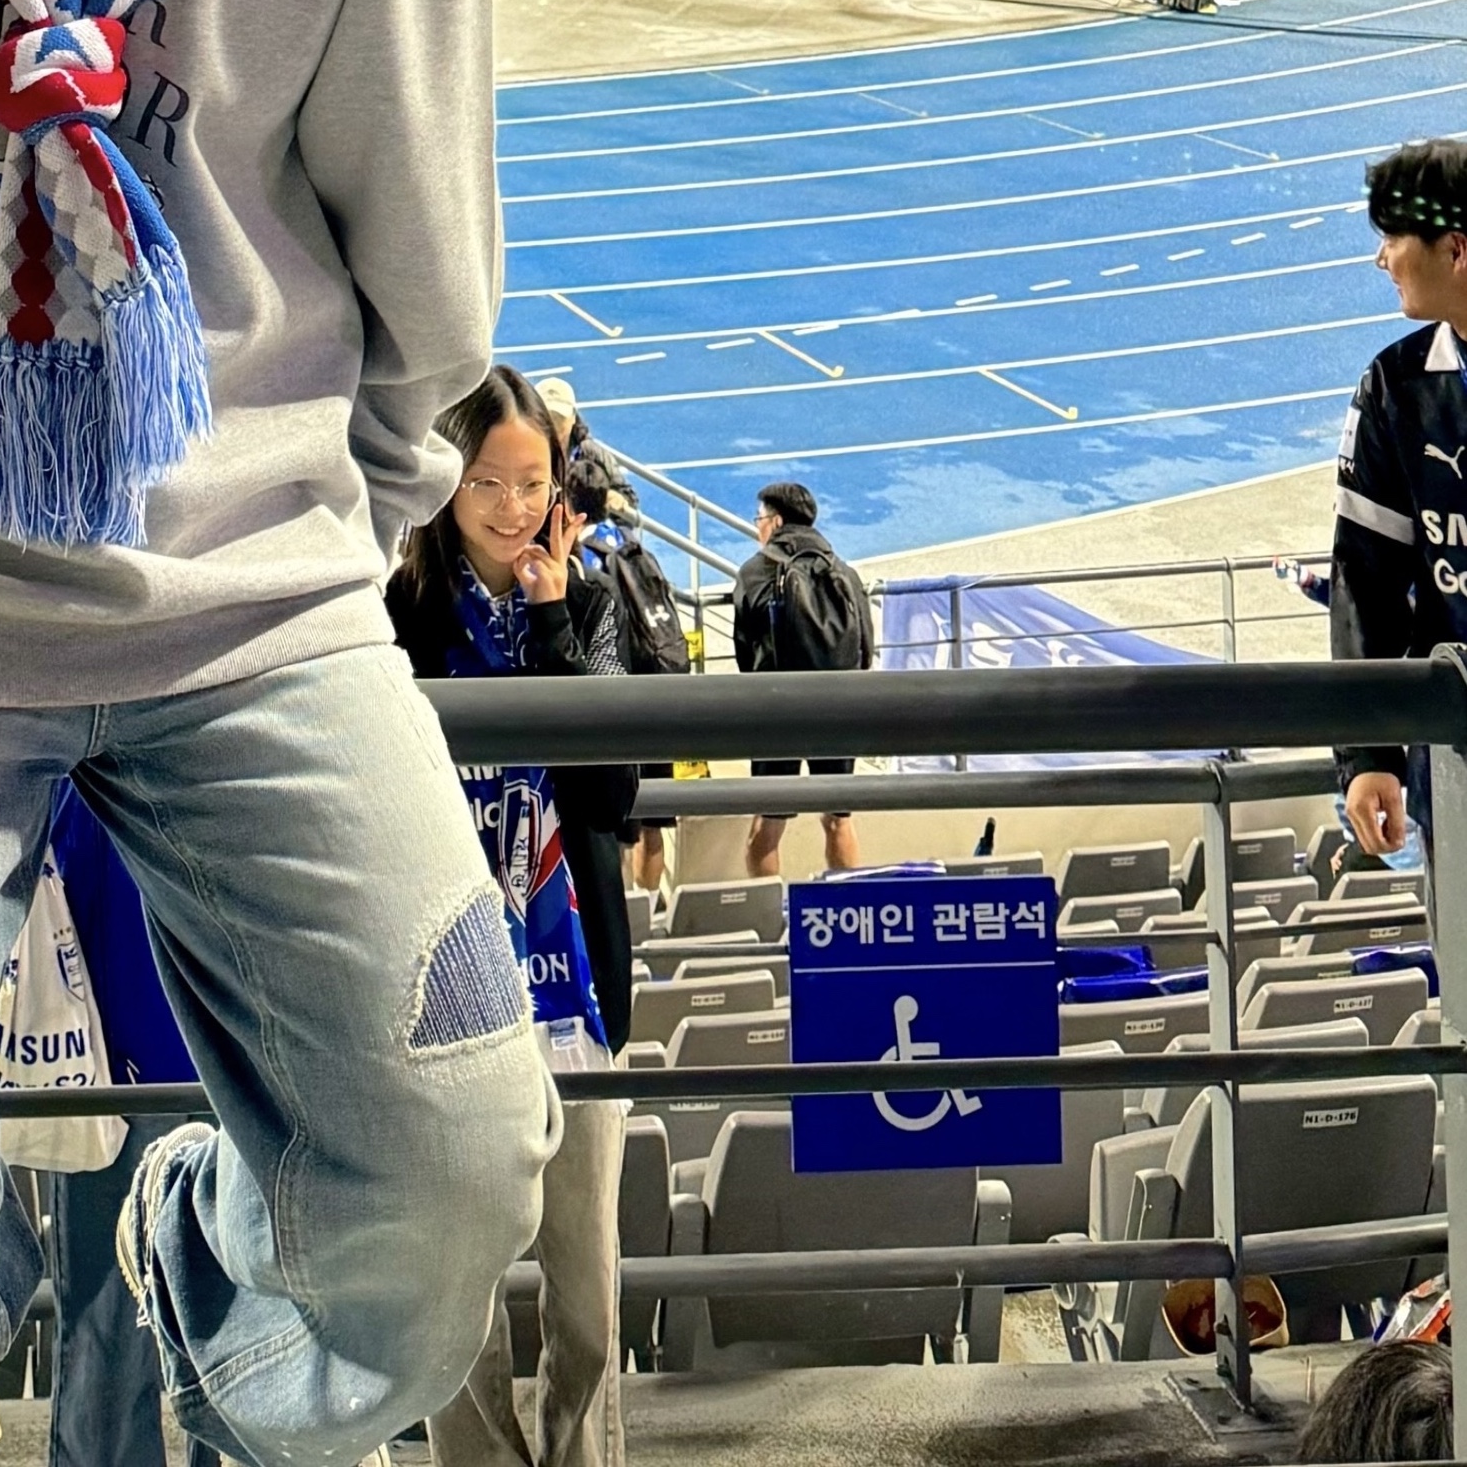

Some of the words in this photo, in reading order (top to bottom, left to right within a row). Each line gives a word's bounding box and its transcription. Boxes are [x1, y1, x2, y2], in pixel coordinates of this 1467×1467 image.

[801, 904, 915, 948] 장애인
[933, 901, 1046, 941] 관람석
[1305, 1111, 1356, 1124] N1-D-176
